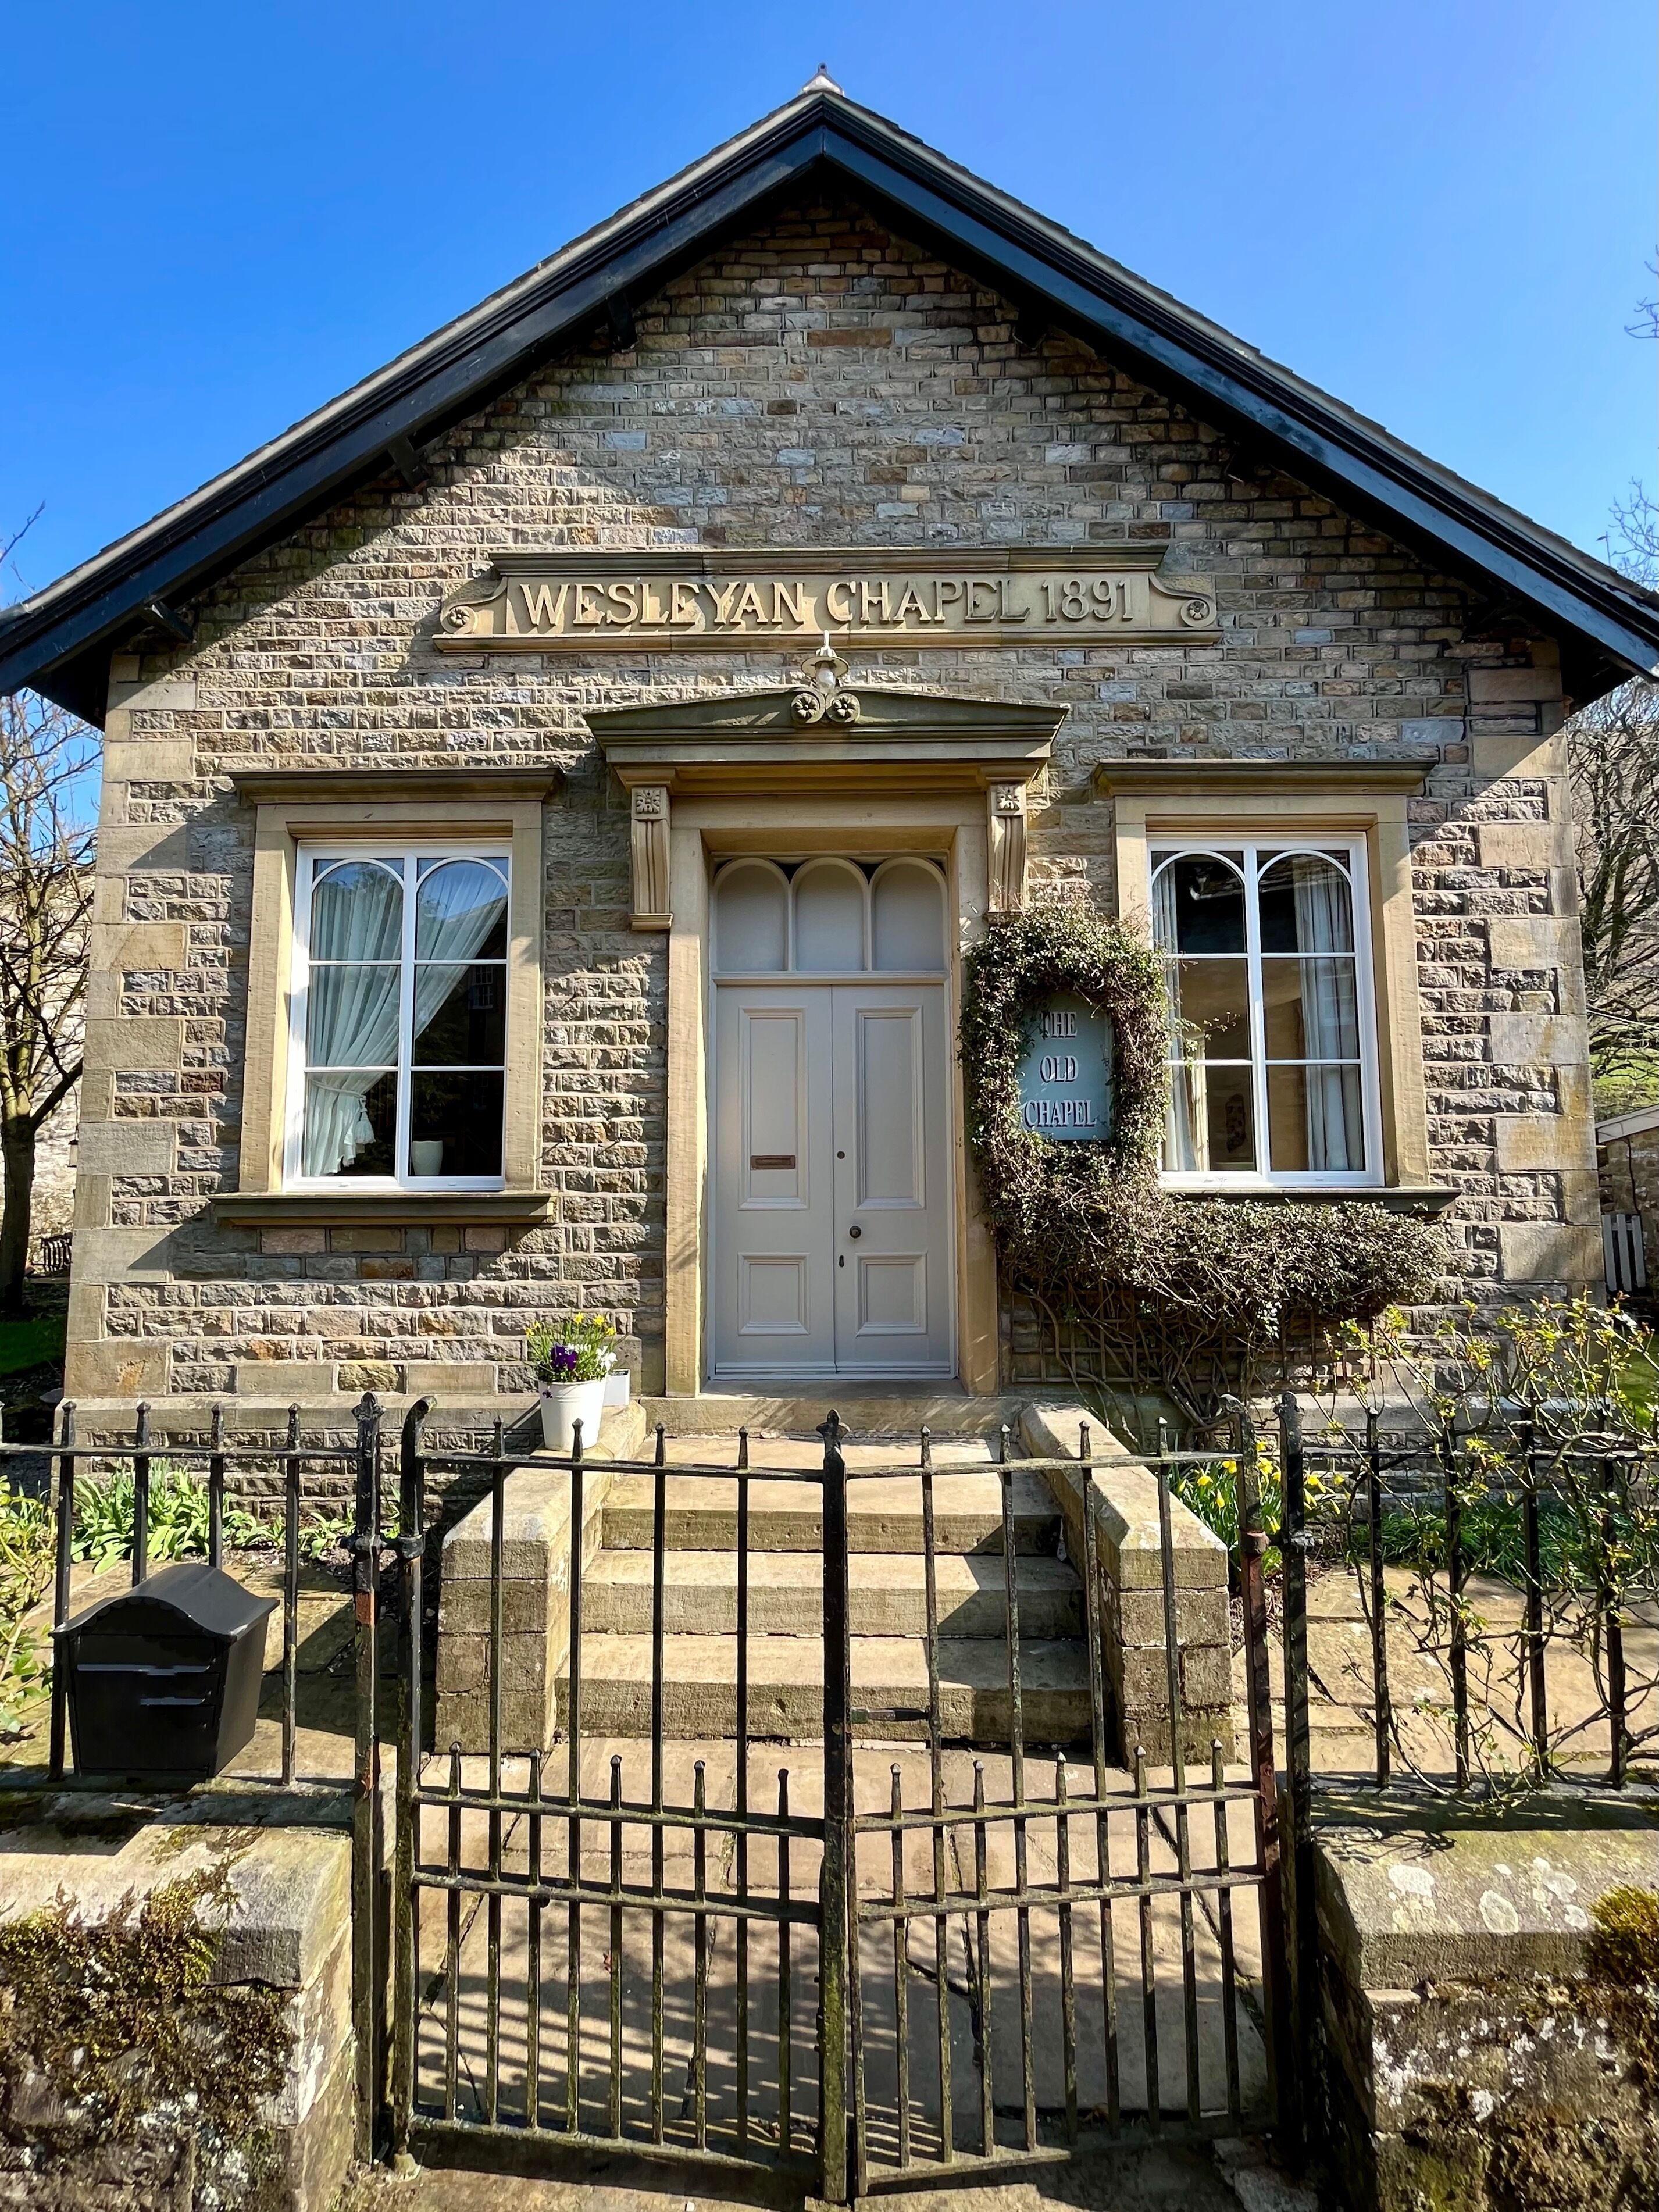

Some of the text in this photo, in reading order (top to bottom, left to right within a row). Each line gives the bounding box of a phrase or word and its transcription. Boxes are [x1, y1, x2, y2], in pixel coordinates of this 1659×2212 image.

[520, 579, 1134, 625] WESLEYAN CHAPEL 1891
[1039, 1011, 1078, 1039] THE
[1040, 1055, 1079, 1083] OLD
[1024, 1099, 1097, 1128] CHAPEL
